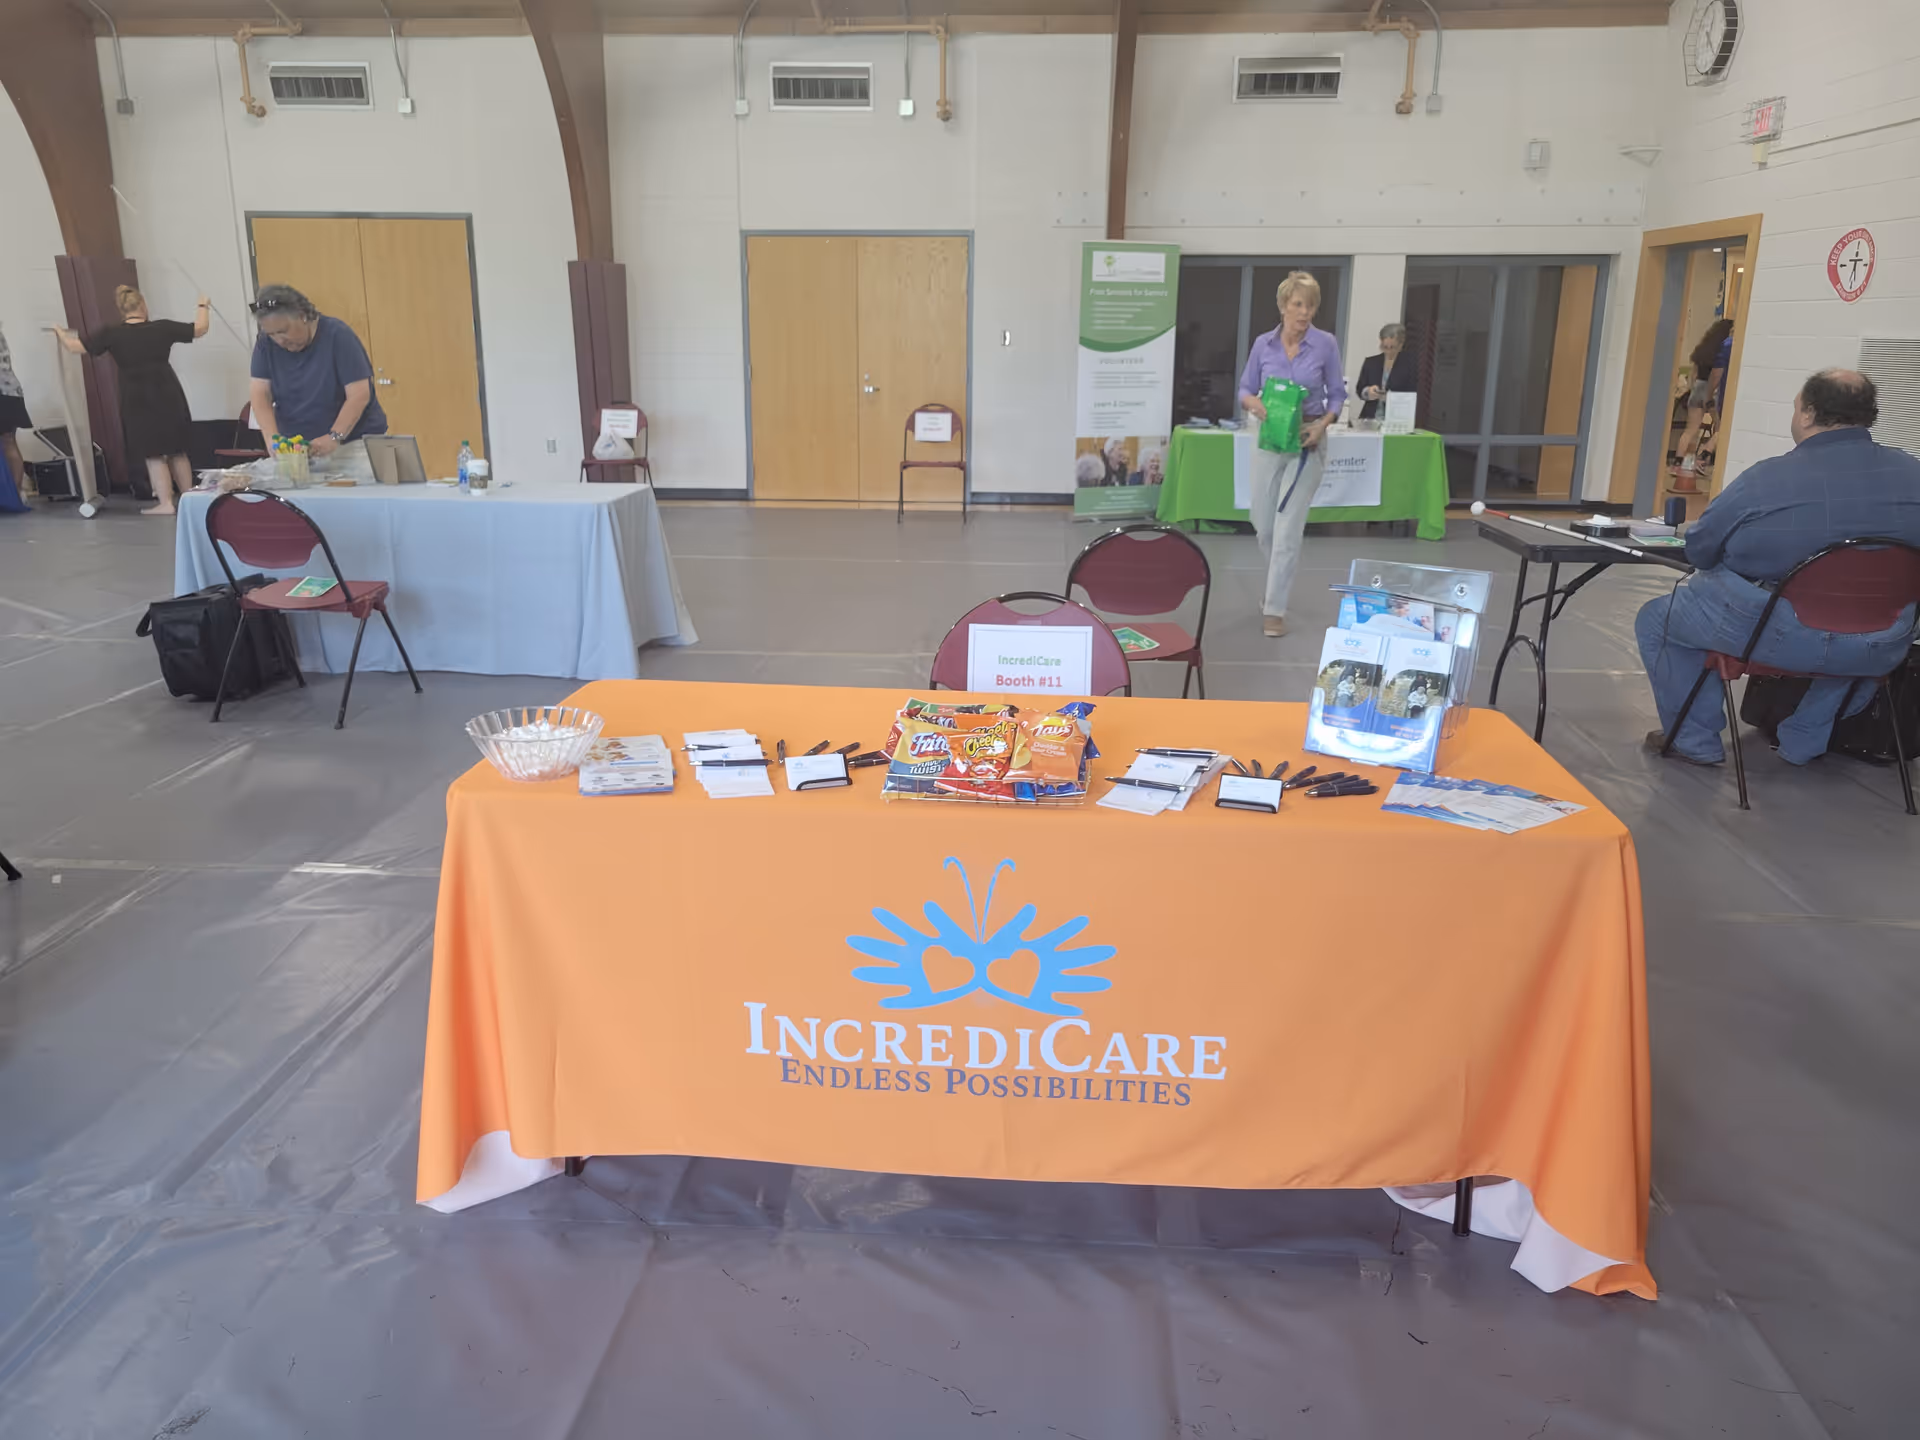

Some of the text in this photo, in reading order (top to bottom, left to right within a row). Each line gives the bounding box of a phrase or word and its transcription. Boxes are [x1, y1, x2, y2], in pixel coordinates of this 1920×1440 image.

[1753, 106, 1773, 136] EXIT
[1829, 243, 1843, 266] KEEP
[998, 655, 1062, 667] IncrediCare
[996, 674, 1062, 688] Booth #11
[780, 1057, 1192, 1107] ENDLESS POSSIBILITIES
